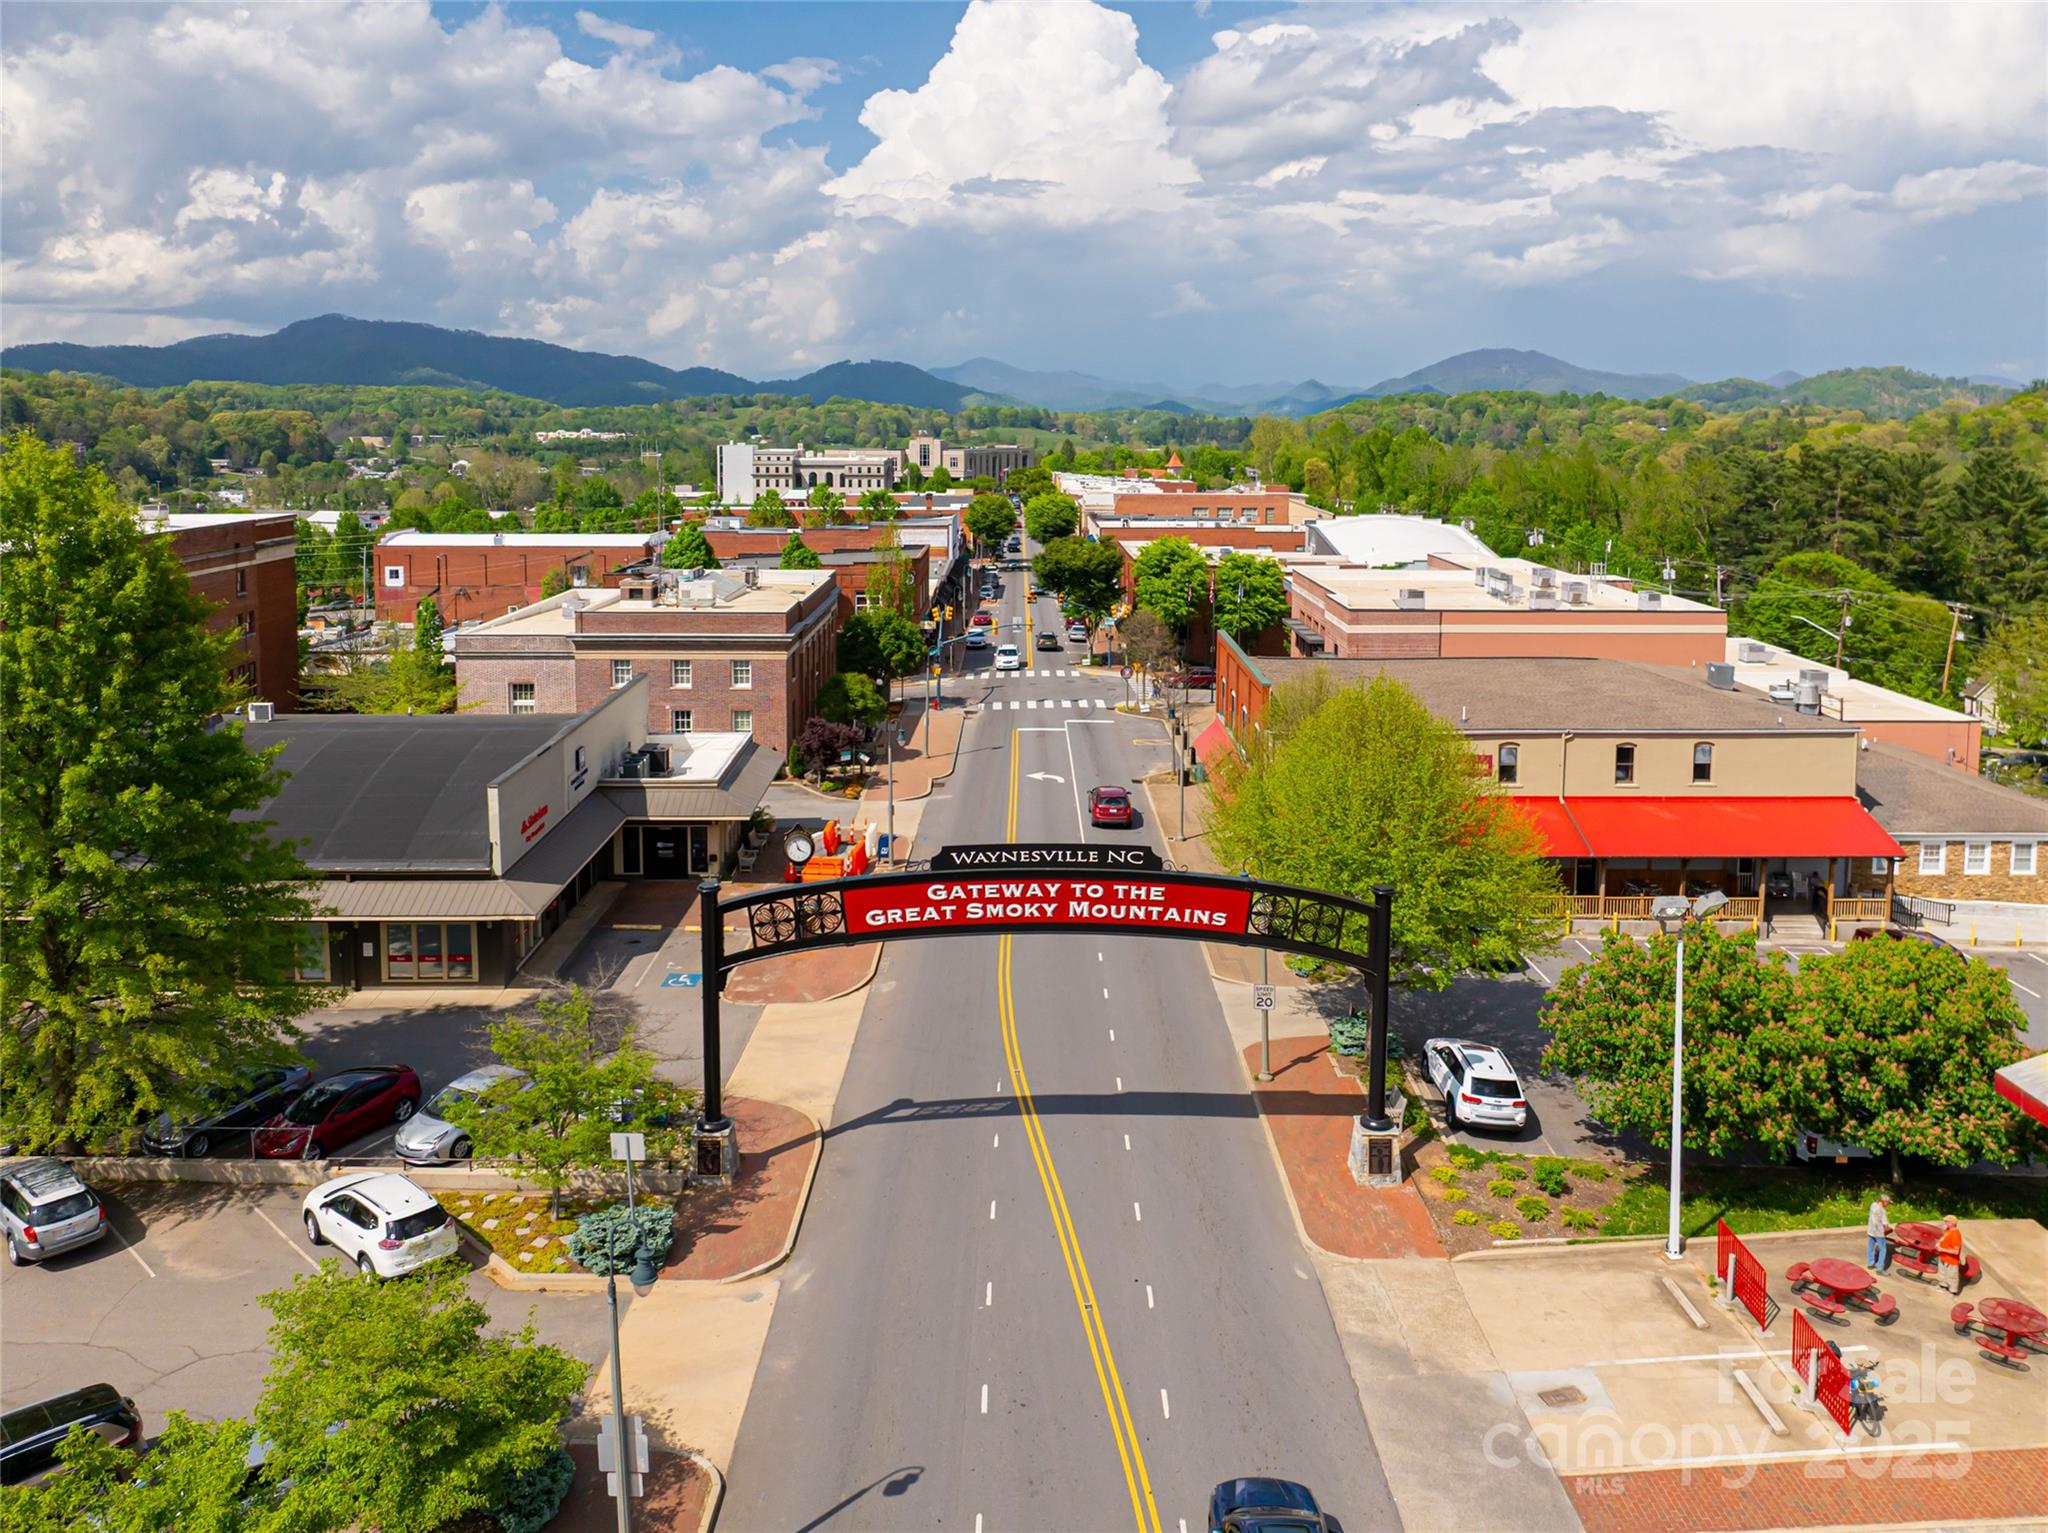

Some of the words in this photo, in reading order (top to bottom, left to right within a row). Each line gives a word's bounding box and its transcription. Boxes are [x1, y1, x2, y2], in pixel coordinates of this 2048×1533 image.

[950, 850, 1098, 865] WAYNESVILLE
[1106, 850, 1144, 865] NC
[927, 882, 1061, 901] GATEWAY
[1071, 883, 1104, 898] TO
[1113, 885, 1166, 901] THE
[865, 905, 956, 926] GREAT
[966, 902, 1058, 919] SMOKY
[1068, 901, 1227, 927] MOUNTAINS
[1256, 998, 1273, 1008] 20
